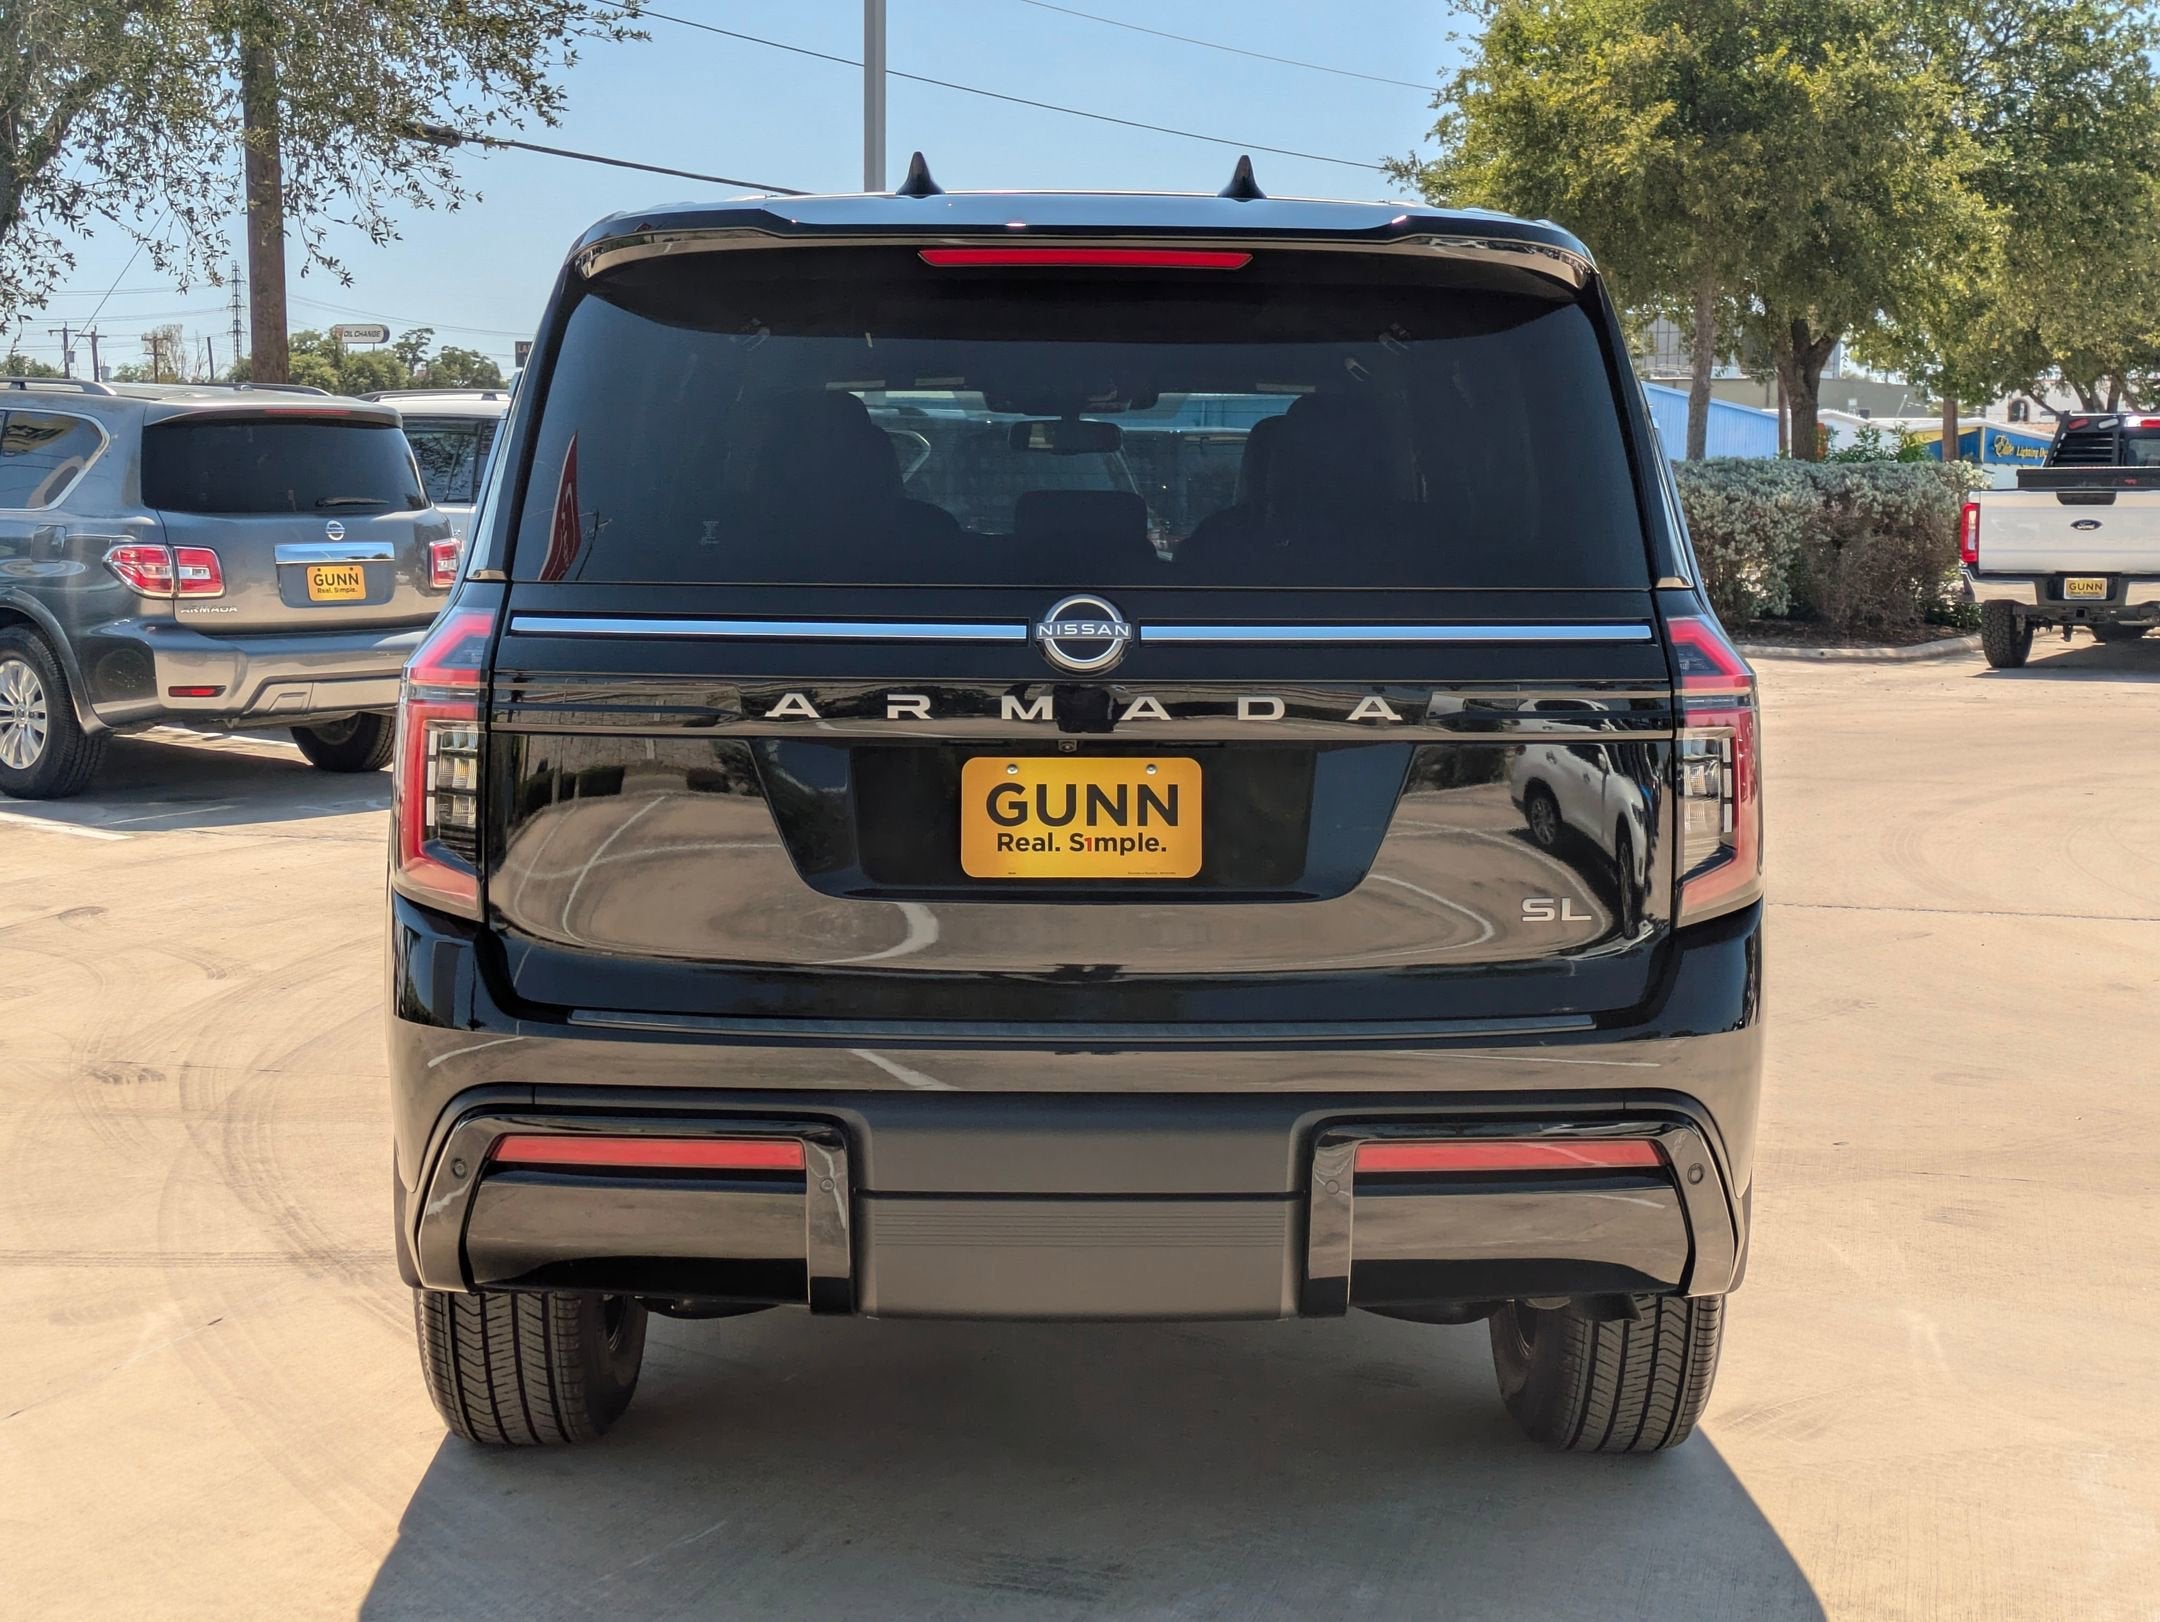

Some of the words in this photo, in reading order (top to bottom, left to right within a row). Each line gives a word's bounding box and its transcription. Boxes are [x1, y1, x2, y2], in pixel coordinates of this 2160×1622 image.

[354, 330, 382, 338] CHANGE
[313, 573, 359, 586] GUNN
[2068, 582, 2103, 591] GUNN
[1038, 623, 1129, 637] NISSAN
[765, 693, 1402, 721] ARMADA
[985, 782, 1179, 827] GUNN
[997, 832, 1061, 852] Real.
[1521, 898, 1592, 922] SL
